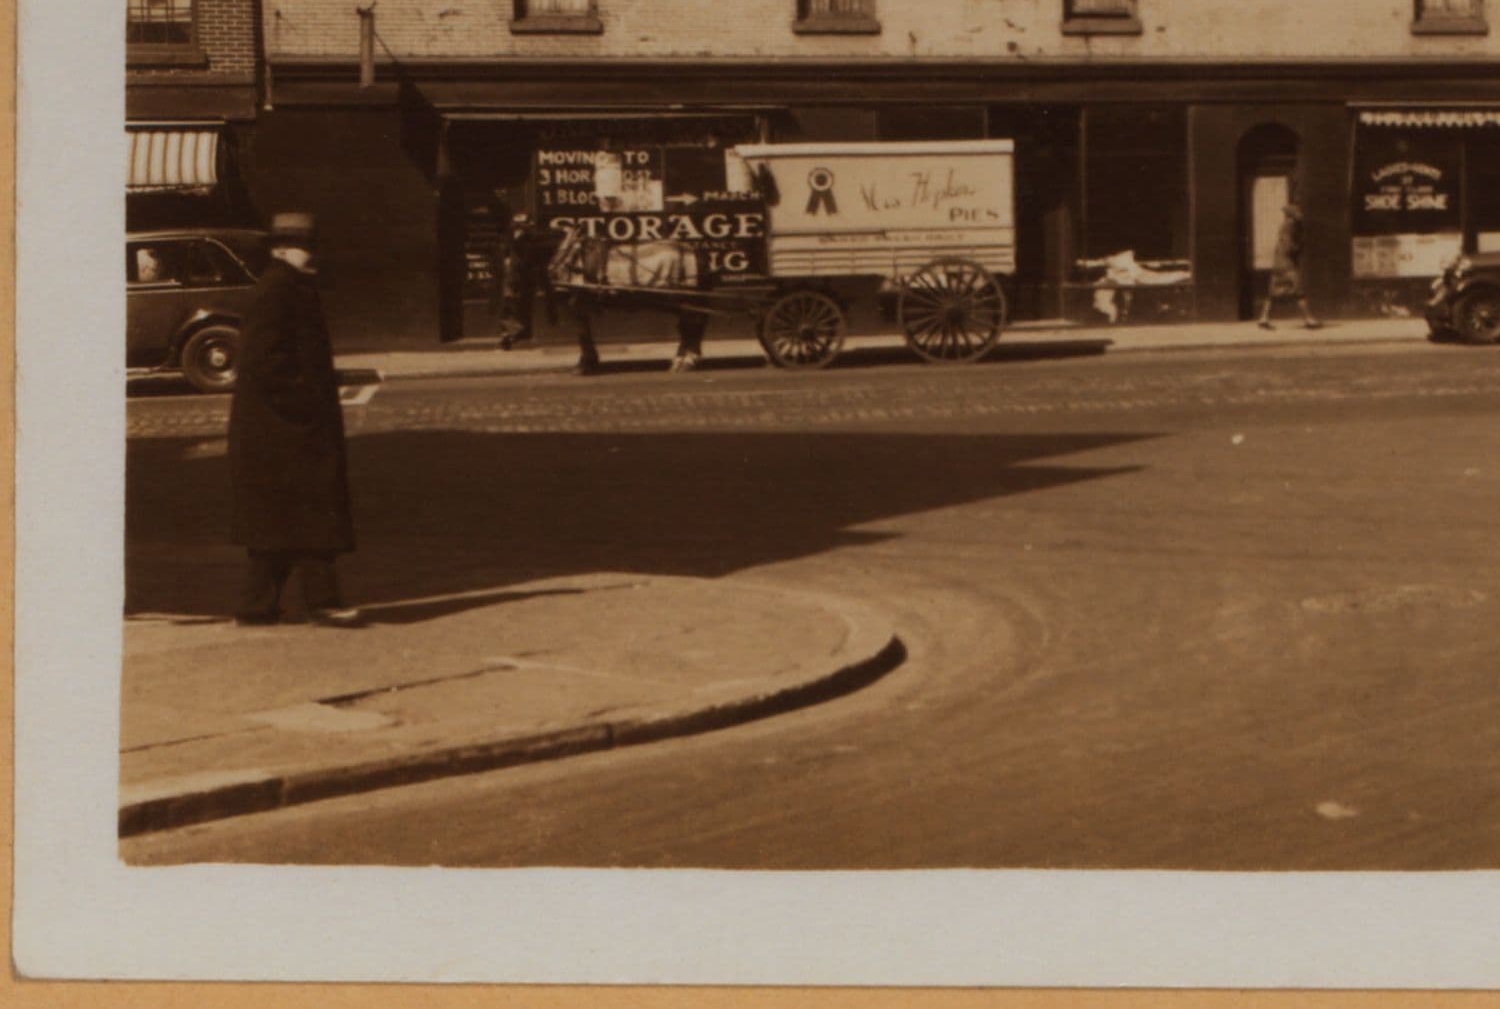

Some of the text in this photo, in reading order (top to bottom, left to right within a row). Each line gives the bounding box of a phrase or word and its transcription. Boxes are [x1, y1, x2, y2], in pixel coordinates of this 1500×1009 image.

[624, 150, 650, 165] TO
[539, 169, 551, 186] 3
[542, 190, 601, 206] 1 BLOC
[549, 214, 764, 241] STORAGE
